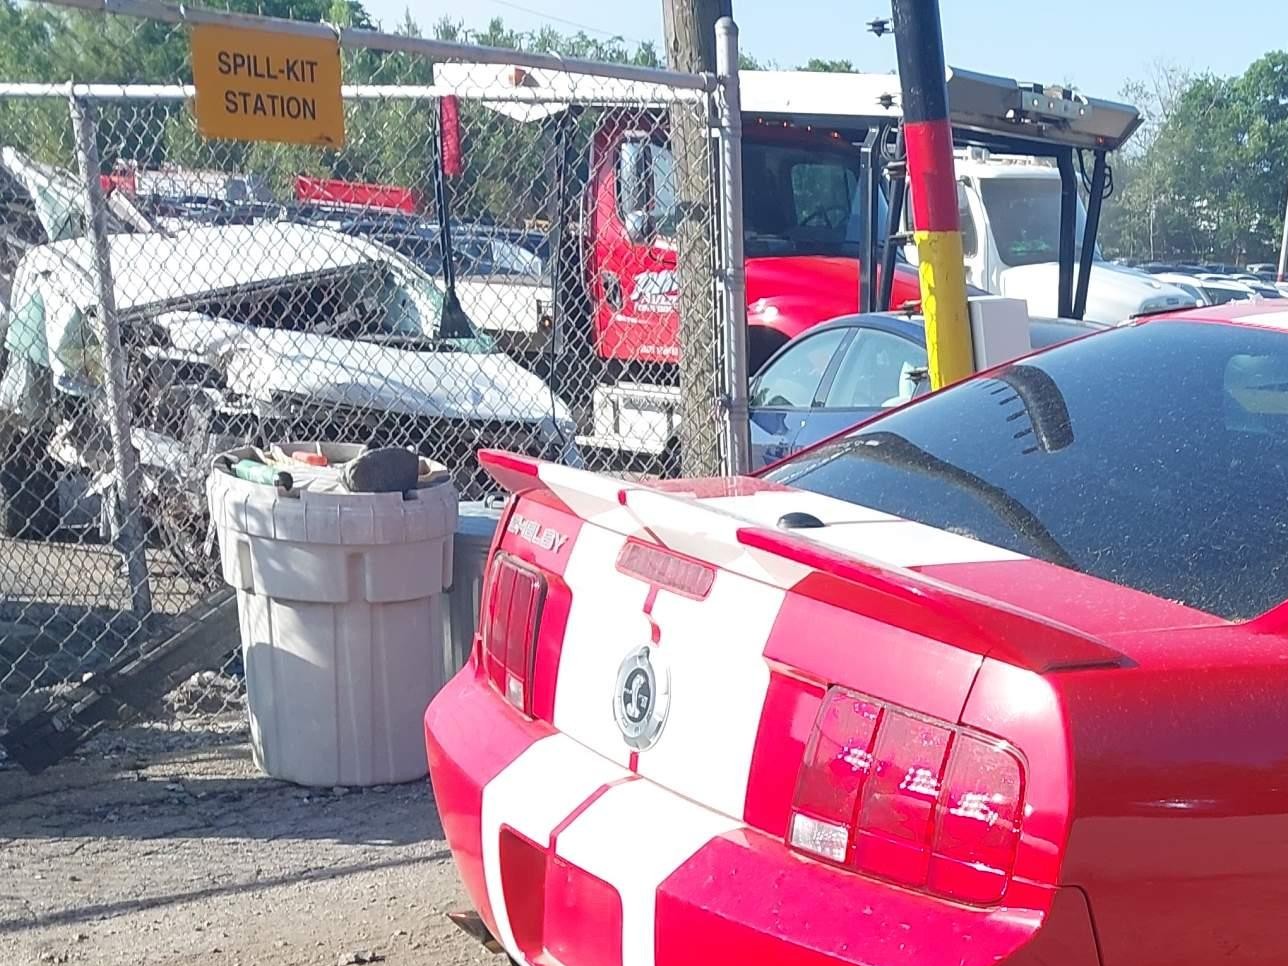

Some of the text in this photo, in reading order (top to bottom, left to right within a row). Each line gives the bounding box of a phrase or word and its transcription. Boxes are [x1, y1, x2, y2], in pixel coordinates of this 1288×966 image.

[217, 51, 318, 83] SPILL-KIT
[224, 89, 316, 121] STATION
[507, 513, 569, 553] SHELBY
